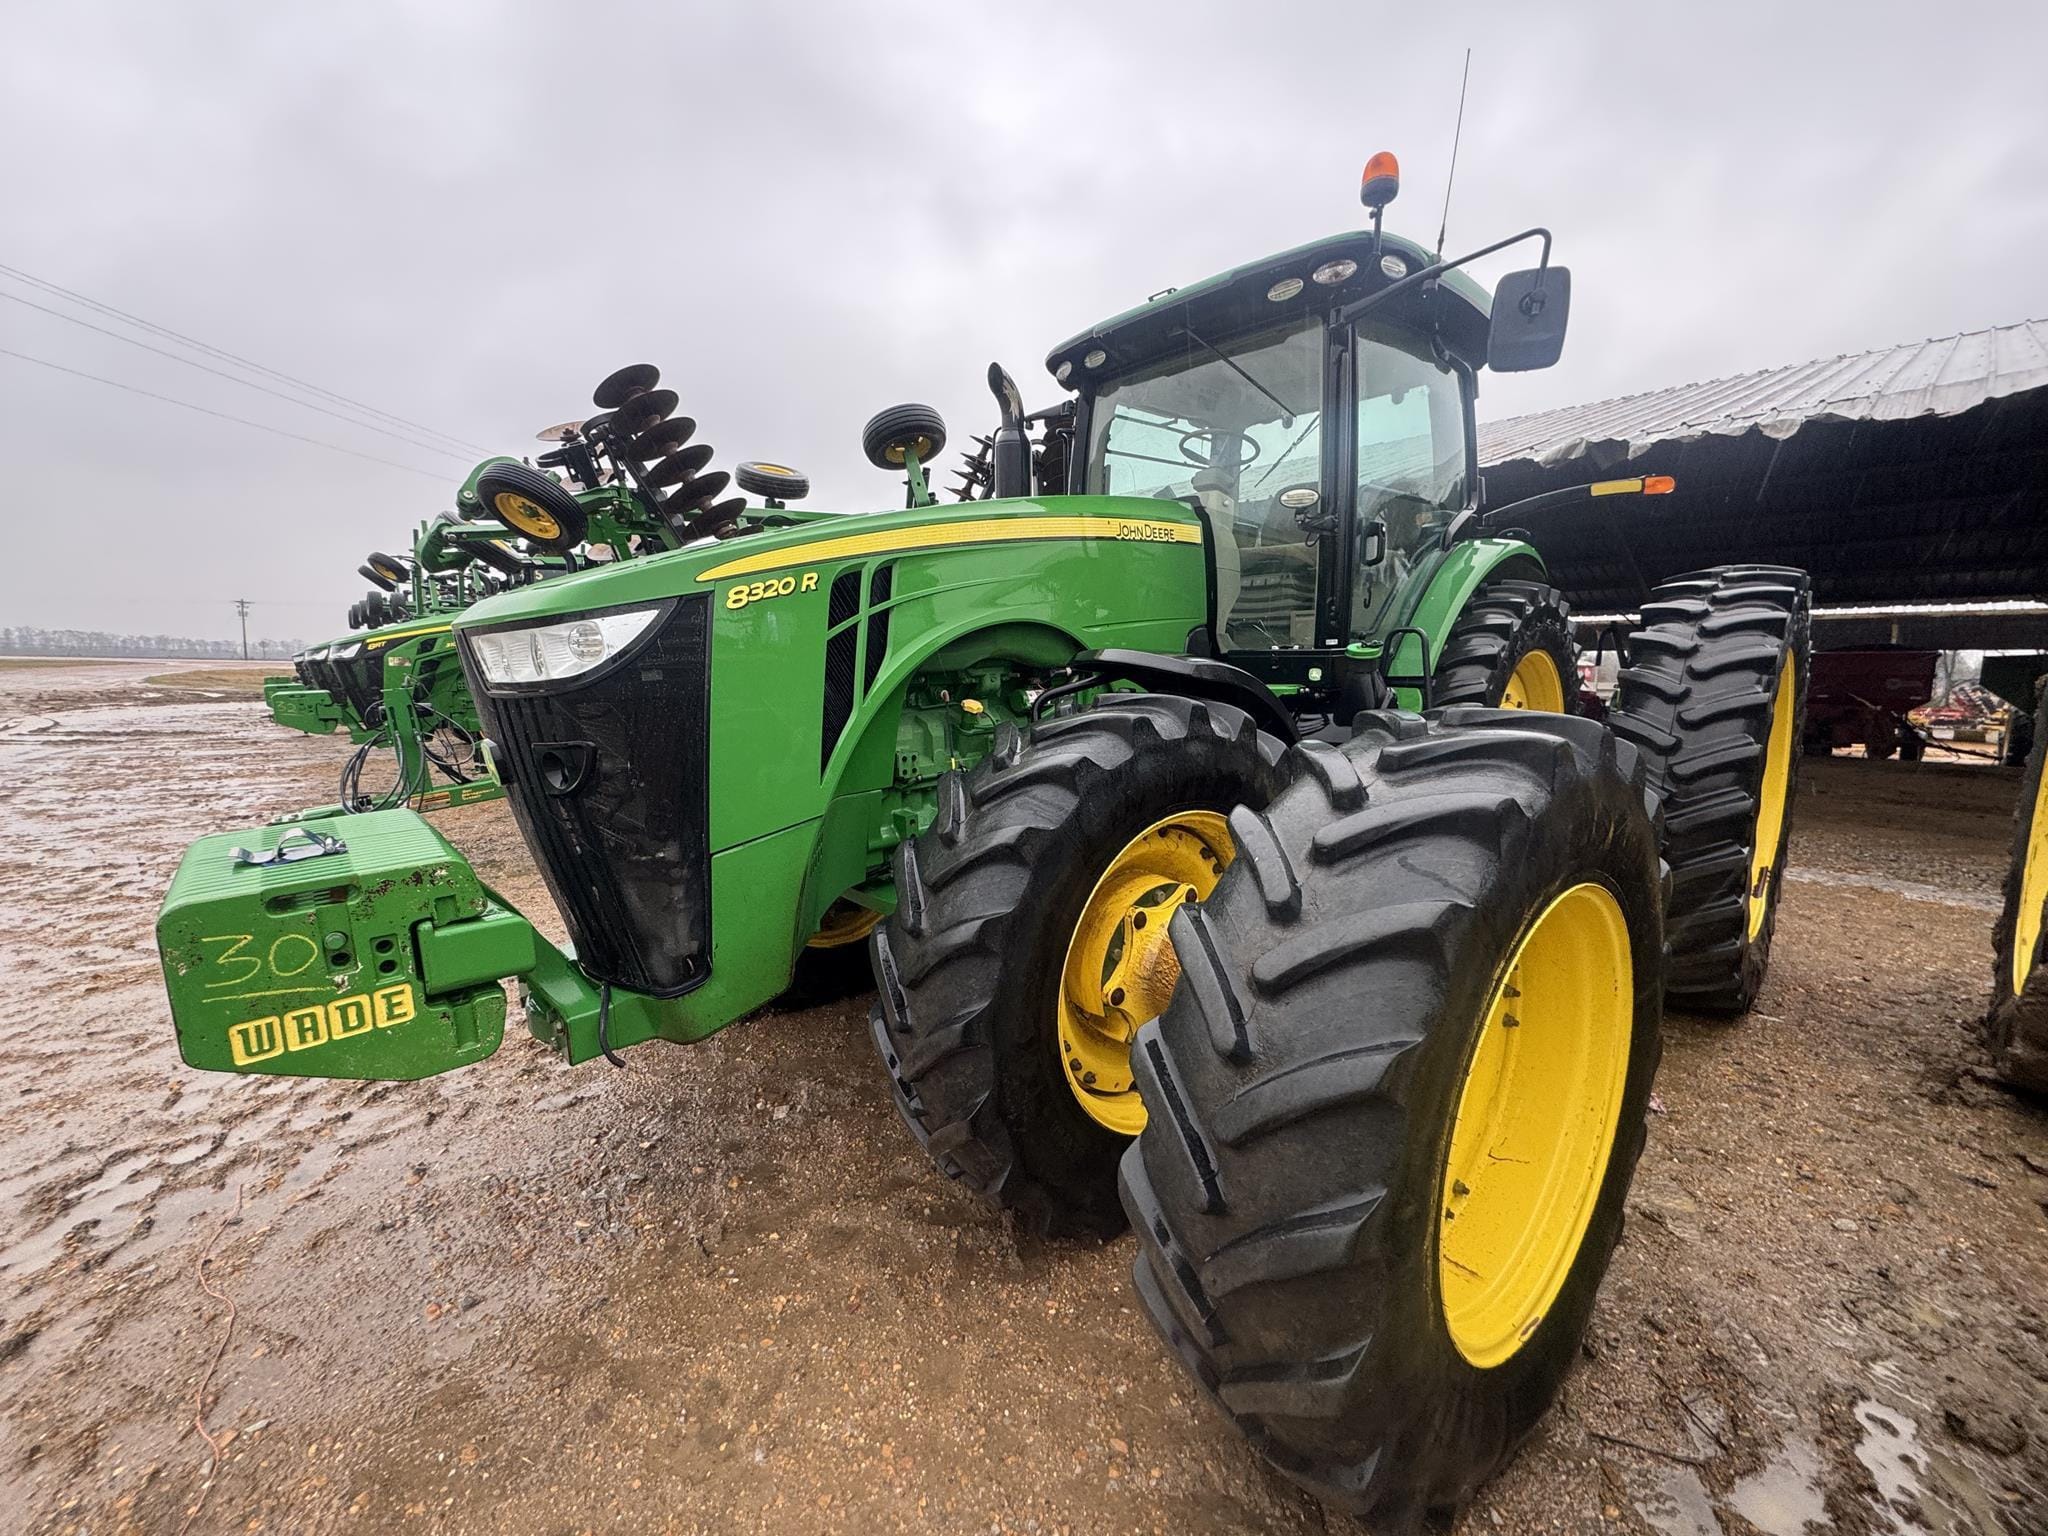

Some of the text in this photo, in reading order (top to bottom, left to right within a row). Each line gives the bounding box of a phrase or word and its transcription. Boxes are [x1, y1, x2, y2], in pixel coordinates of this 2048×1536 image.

[726, 572, 819, 610] 8320 R
[201, 934, 319, 988] 30
[233, 985, 413, 1062] WADE
